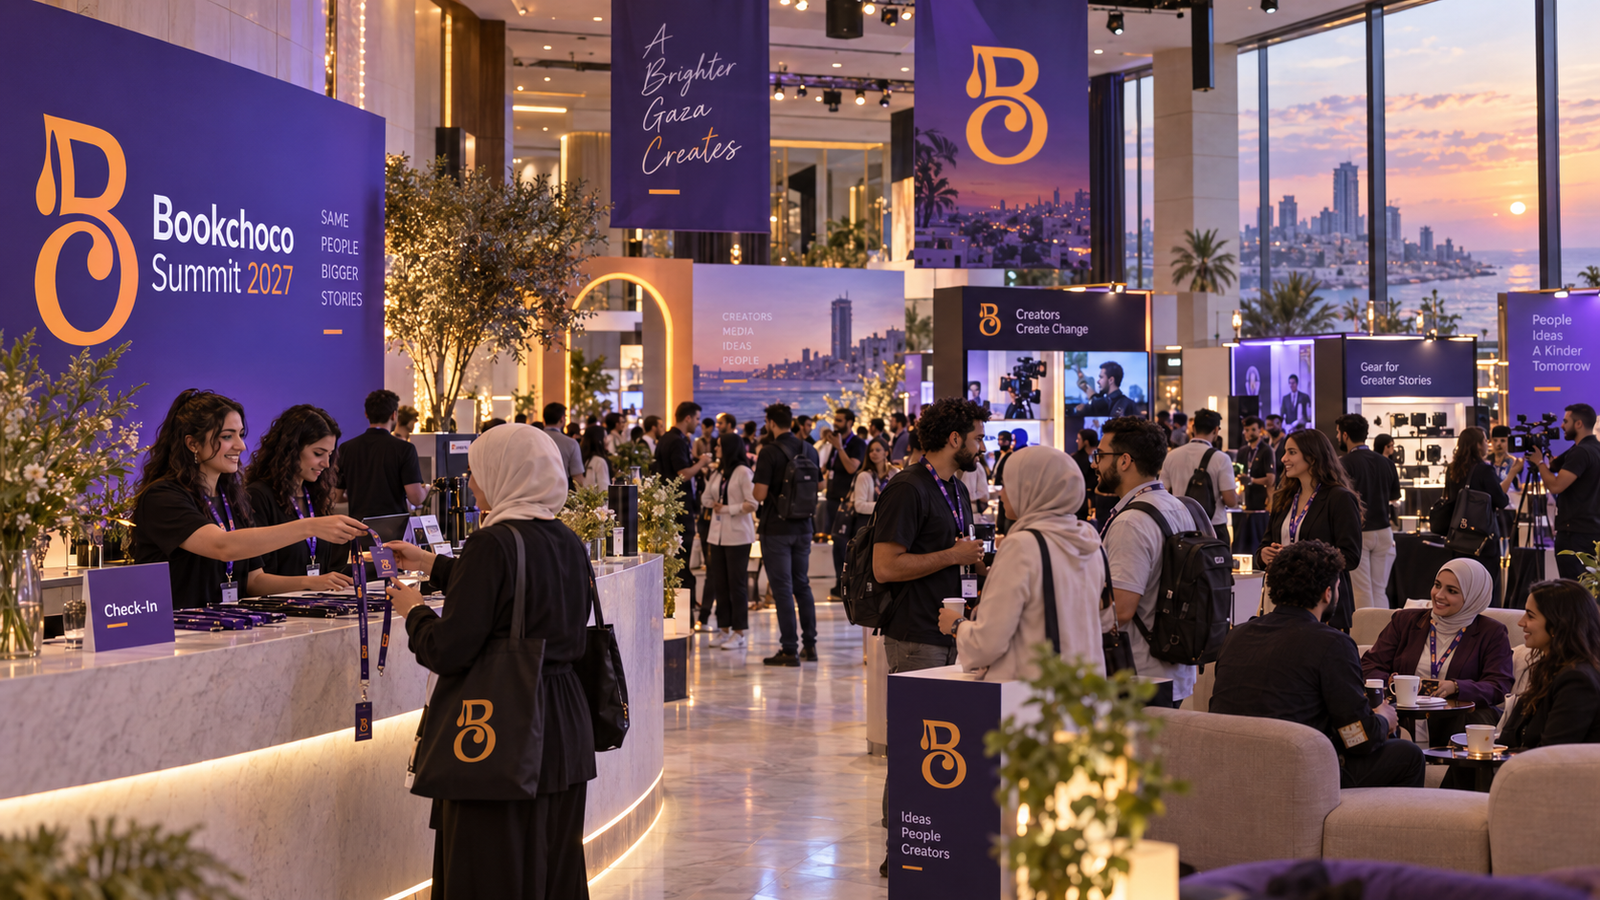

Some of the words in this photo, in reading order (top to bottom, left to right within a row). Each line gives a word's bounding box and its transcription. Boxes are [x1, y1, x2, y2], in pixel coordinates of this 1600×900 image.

[642, 23, 673, 59] A
[641, 52, 737, 97] Brighter
[642, 96, 712, 133] Gaza
[642, 127, 742, 175] Creates
[153, 194, 294, 254] Bookchoco
[321, 210, 349, 228] SAME
[321, 237, 359, 255] PEOPLE
[151, 253, 241, 293] Summit
[247, 262, 293, 295] 2027
[321, 264, 359, 281] BIGGER
[321, 290, 363, 307] STORIES
[722, 312, 773, 321] CREATORS
[1016, 308, 1060, 320] Creators
[1532, 314, 1572, 328] People
[722, 327, 754, 336] MEDIA
[1016, 323, 1050, 334] Create
[1052, 323, 1089, 337] Change
[1532, 330, 1563, 341] Ideas
[722, 341, 752, 351] IDEAS
[1532, 345, 1541, 356] A
[1545, 344, 1583, 356] Kinder
[722, 356, 759, 365] PEOPLE
[1360, 361, 1383, 372] Gear
[1385, 361, 1399, 372] for
[1532, 361, 1591, 372] Tomorrow
[1360, 375, 1396, 386] Greater
[1398, 375, 1432, 386] Stories
[104, 601, 158, 618] Check-In
[901, 811, 931, 825] Ideas
[901, 827, 941, 843] People
[901, 843, 950, 859] Creators
